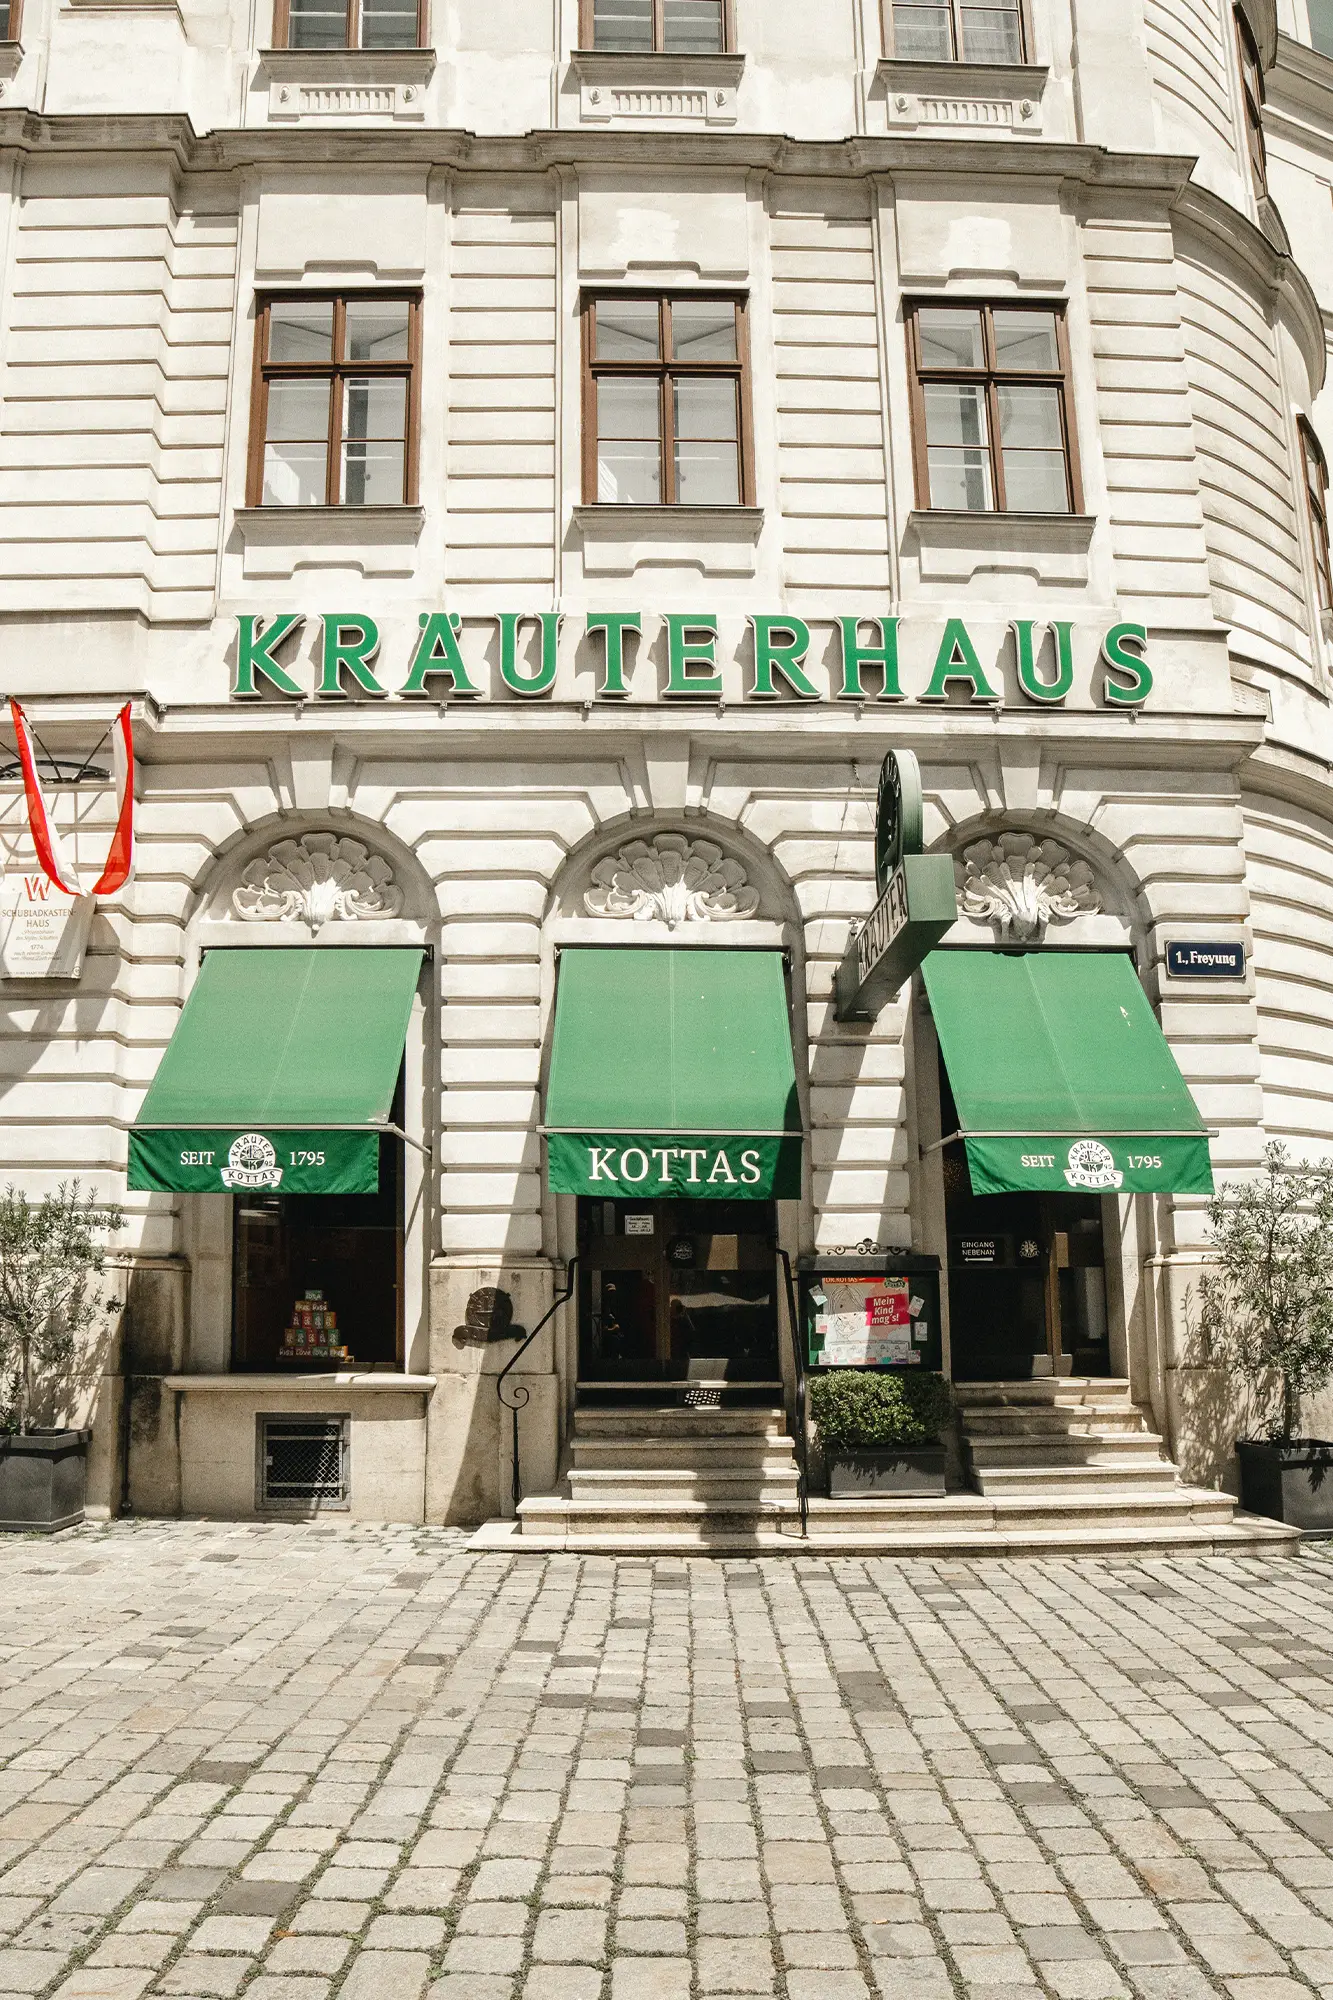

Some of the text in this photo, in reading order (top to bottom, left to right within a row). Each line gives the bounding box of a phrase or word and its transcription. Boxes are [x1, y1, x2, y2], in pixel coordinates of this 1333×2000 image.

[231, 612, 1155, 707] KRÄUTERHAUS
[26, 919, 50, 928] HAUS
[1189, 950, 1236, 966] Freyung
[180, 1151, 215, 1165] SEIT
[289, 1151, 326, 1166] 1795
[1021, 1155, 1055, 1168] SEIT
[1127, 1155, 1163, 1169] 1795
[588, 1147, 761, 1184] KOTTAS
[228, 1170, 275, 1183] KOTTAS
[1070, 1172, 1117, 1184] KOTTAS
[961, 1241, 995, 1249] EINGANG
[873, 1297, 895, 1307] Mein
[874, 1305, 894, 1315] Kind
